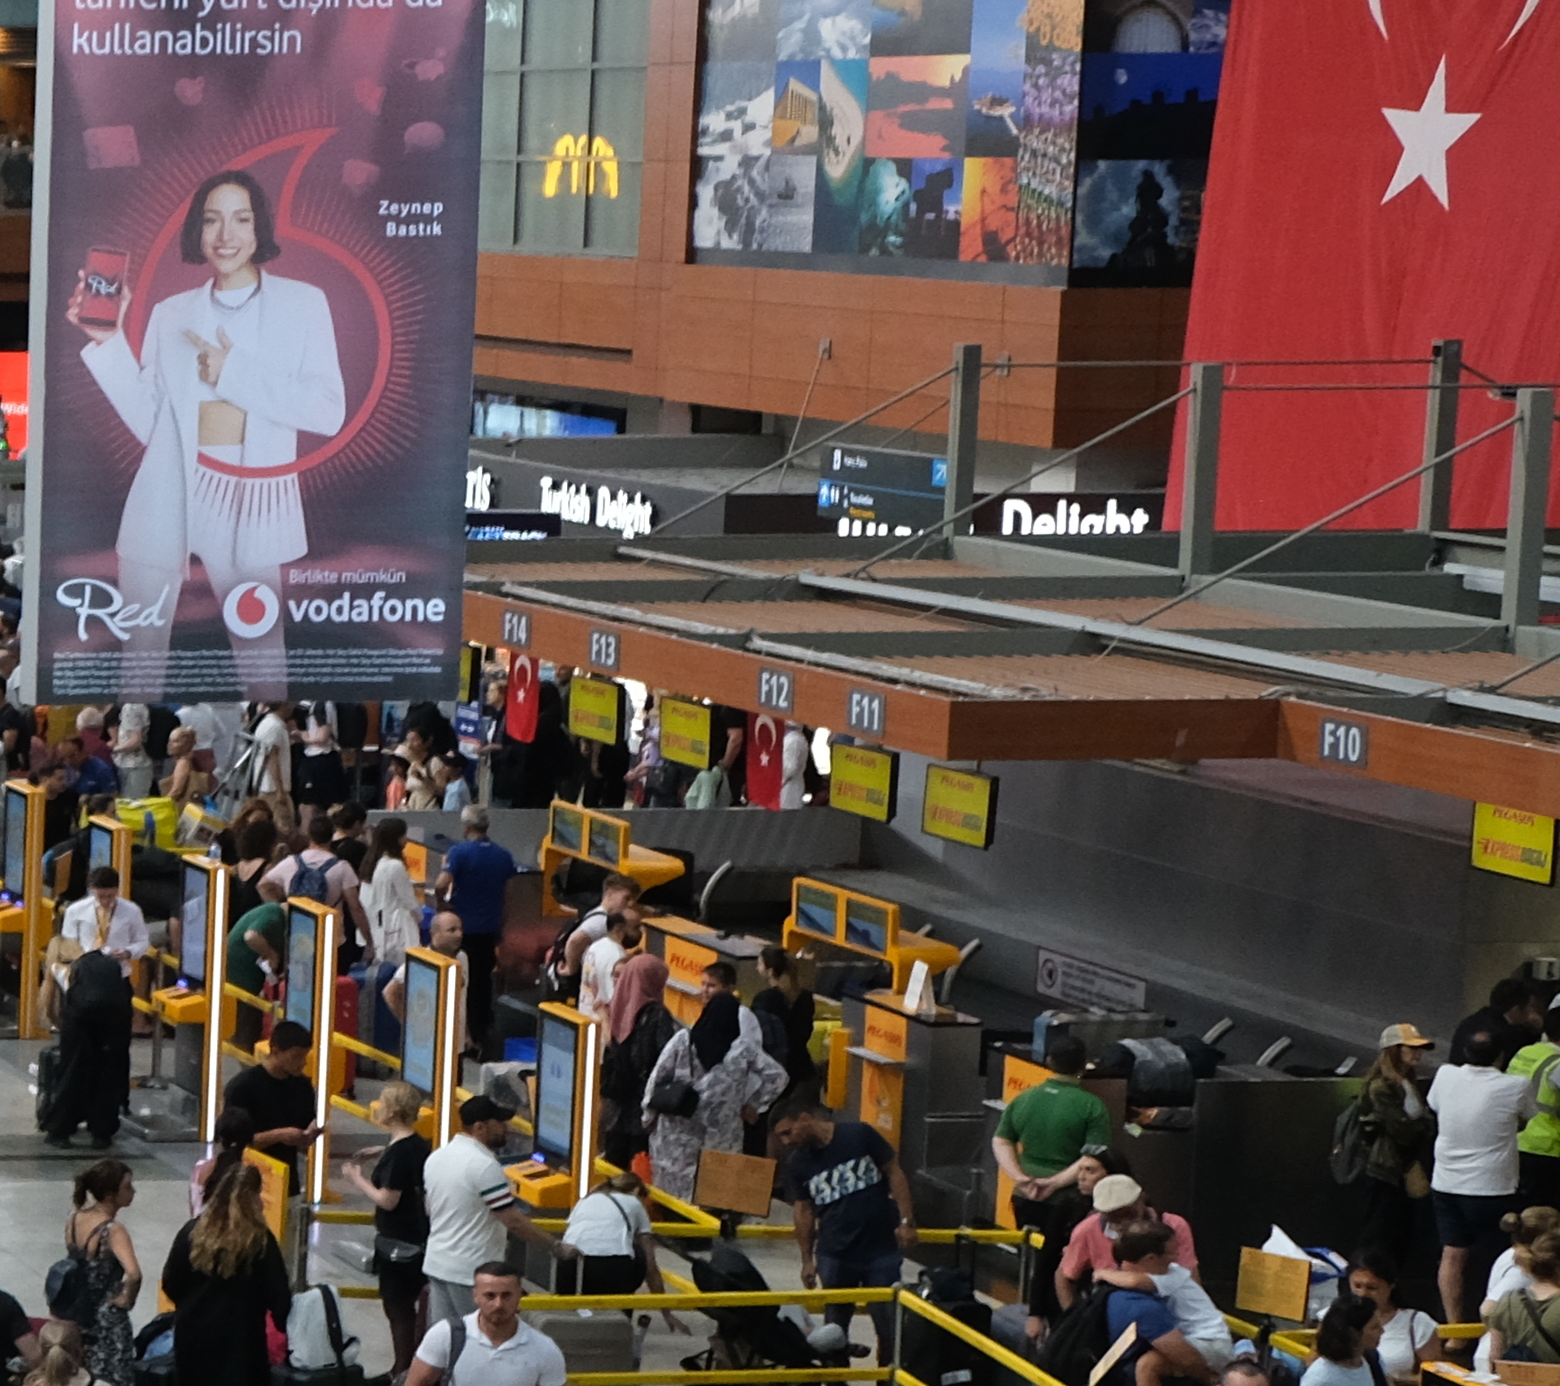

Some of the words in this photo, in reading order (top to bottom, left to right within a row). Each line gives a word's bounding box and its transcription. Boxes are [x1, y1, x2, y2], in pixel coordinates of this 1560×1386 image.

[72, 22, 302, 56] kullanabilirsin
[379, 200, 445, 218] Zeynep
[289, 568, 338, 585] Birlikte
[342, 567, 406, 585] mümkün
[55, 577, 170, 642] Red
[287, 590, 446, 624] vodafone
[503, 612, 529, 645] F14
[591, 633, 616, 668] F13
[761, 672, 789, 708] F12
[851, 694, 881, 731] F11
[1324, 722, 1362, 762] F10
